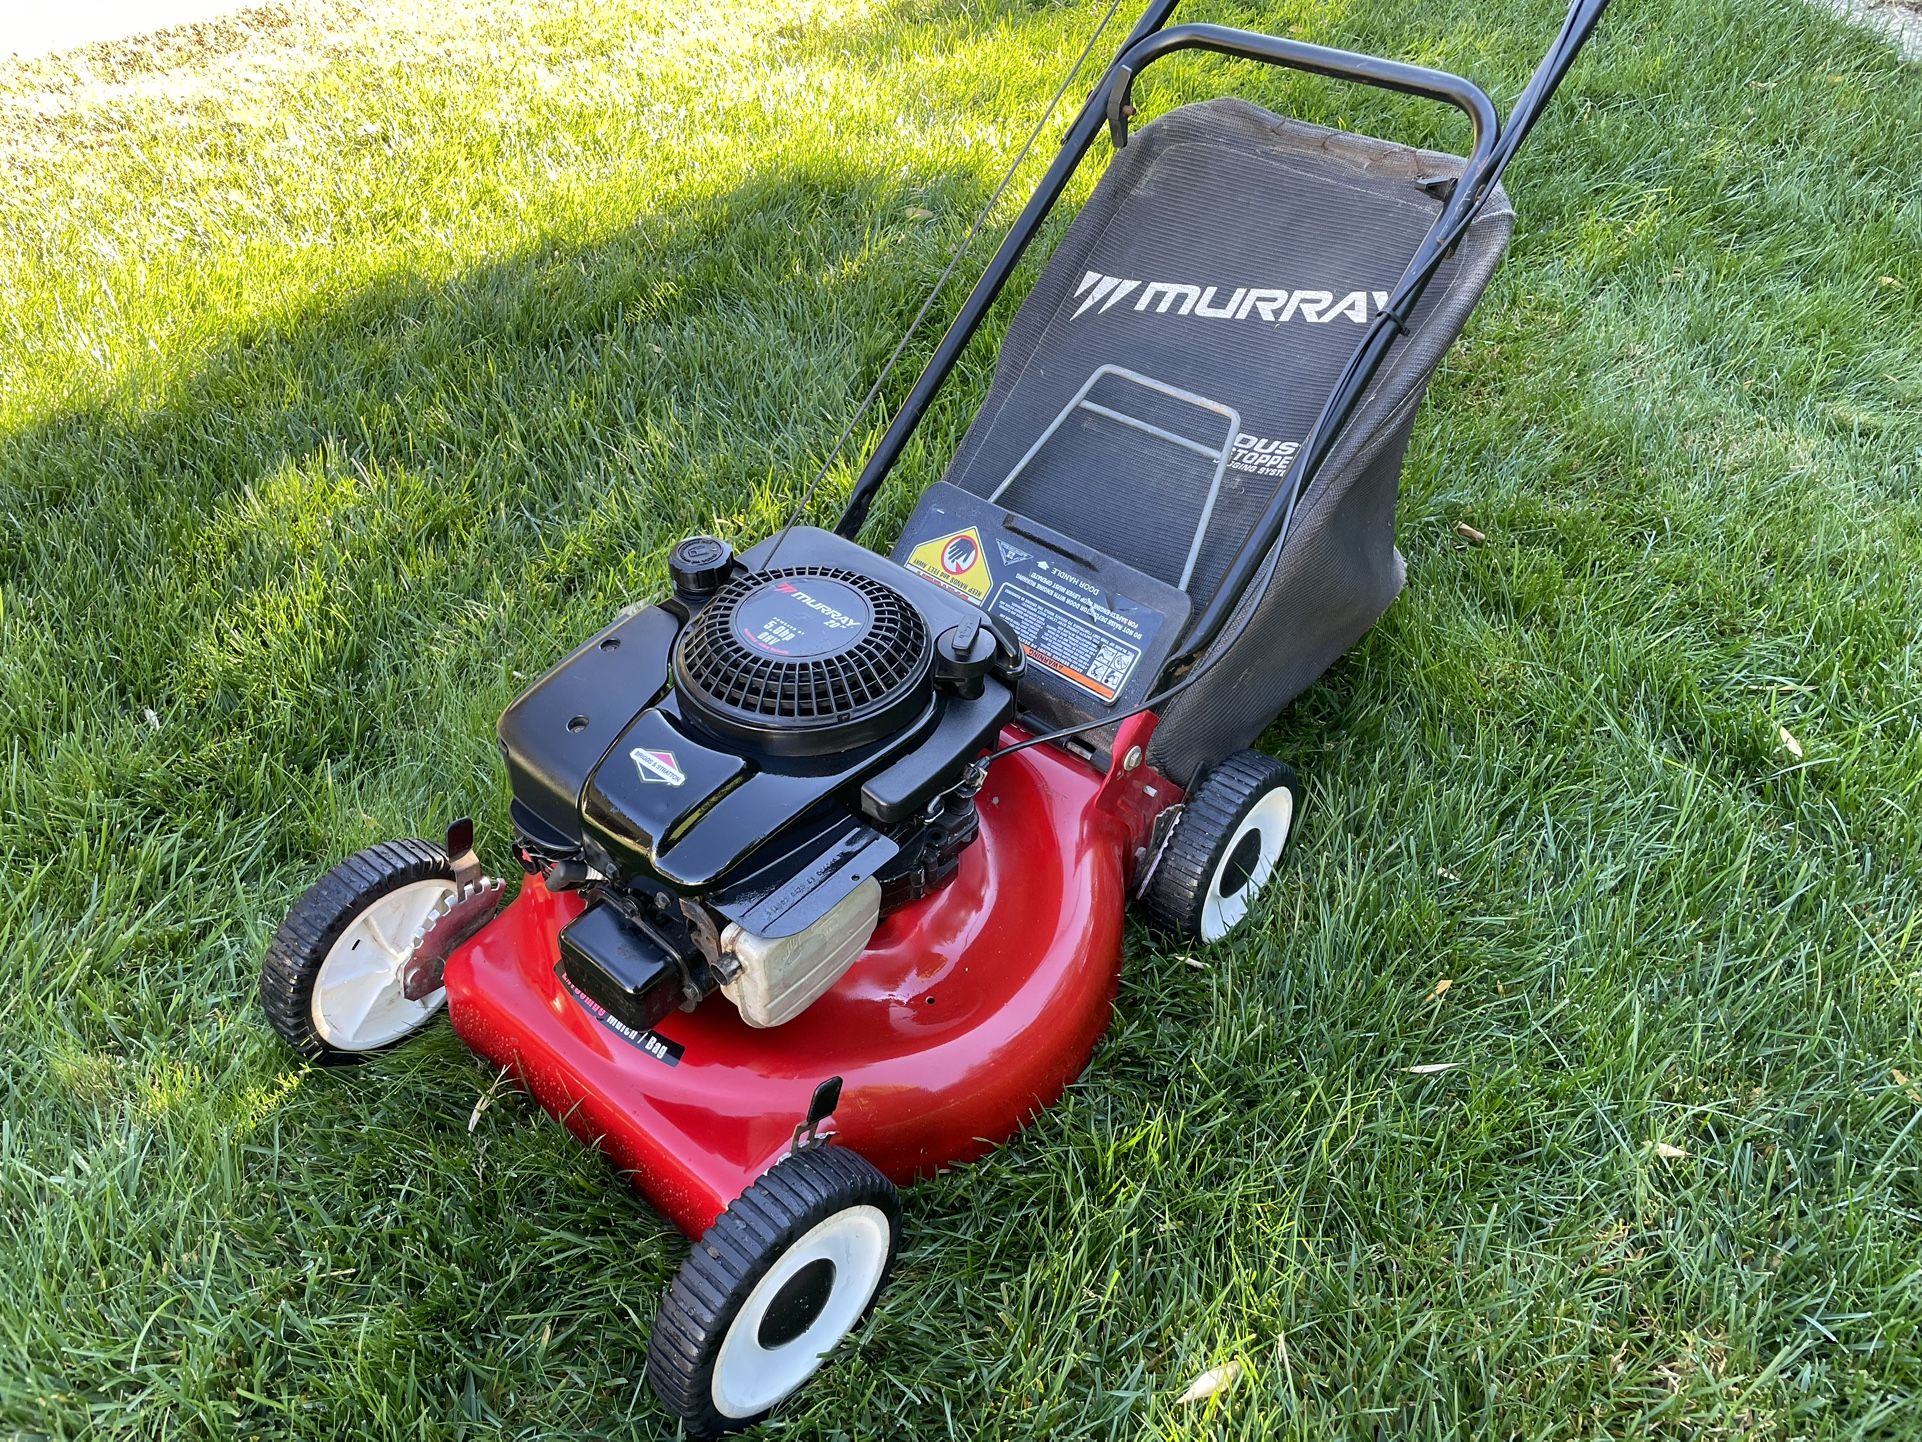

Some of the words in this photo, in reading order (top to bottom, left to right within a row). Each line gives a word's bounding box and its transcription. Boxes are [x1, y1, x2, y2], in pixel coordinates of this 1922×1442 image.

[1234, 432, 1302, 455] DUS
[1231, 447, 1293, 468] TOPPE
[913, 558, 927, 568] AWAY
[928, 566, 940, 576] FEET
[1052, 567, 1079, 585] HANDLE
[950, 577, 968, 589] HANDS
[1052, 582, 1066, 592] MUST
[1078, 580, 1100, 595] DOOR
[968, 587, 982, 597] KEEP
[1053, 592, 1067, 602] WITH
[1066, 589, 1081, 600] LEVER
[791, 592, 861, 627] MURRAY
[1066, 598, 1081, 609] DOOR
[764, 620, 796, 640] 5.0hp
[1123, 626, 1134, 635] NOT
[757, 632, 780, 646] OHV
[1028, 648, 1060, 668] WARNING
[634, 750, 654, 765] BRIGGS
[656, 764, 682, 782] STRATTON
[644, 1036, 668, 1059] Bag
